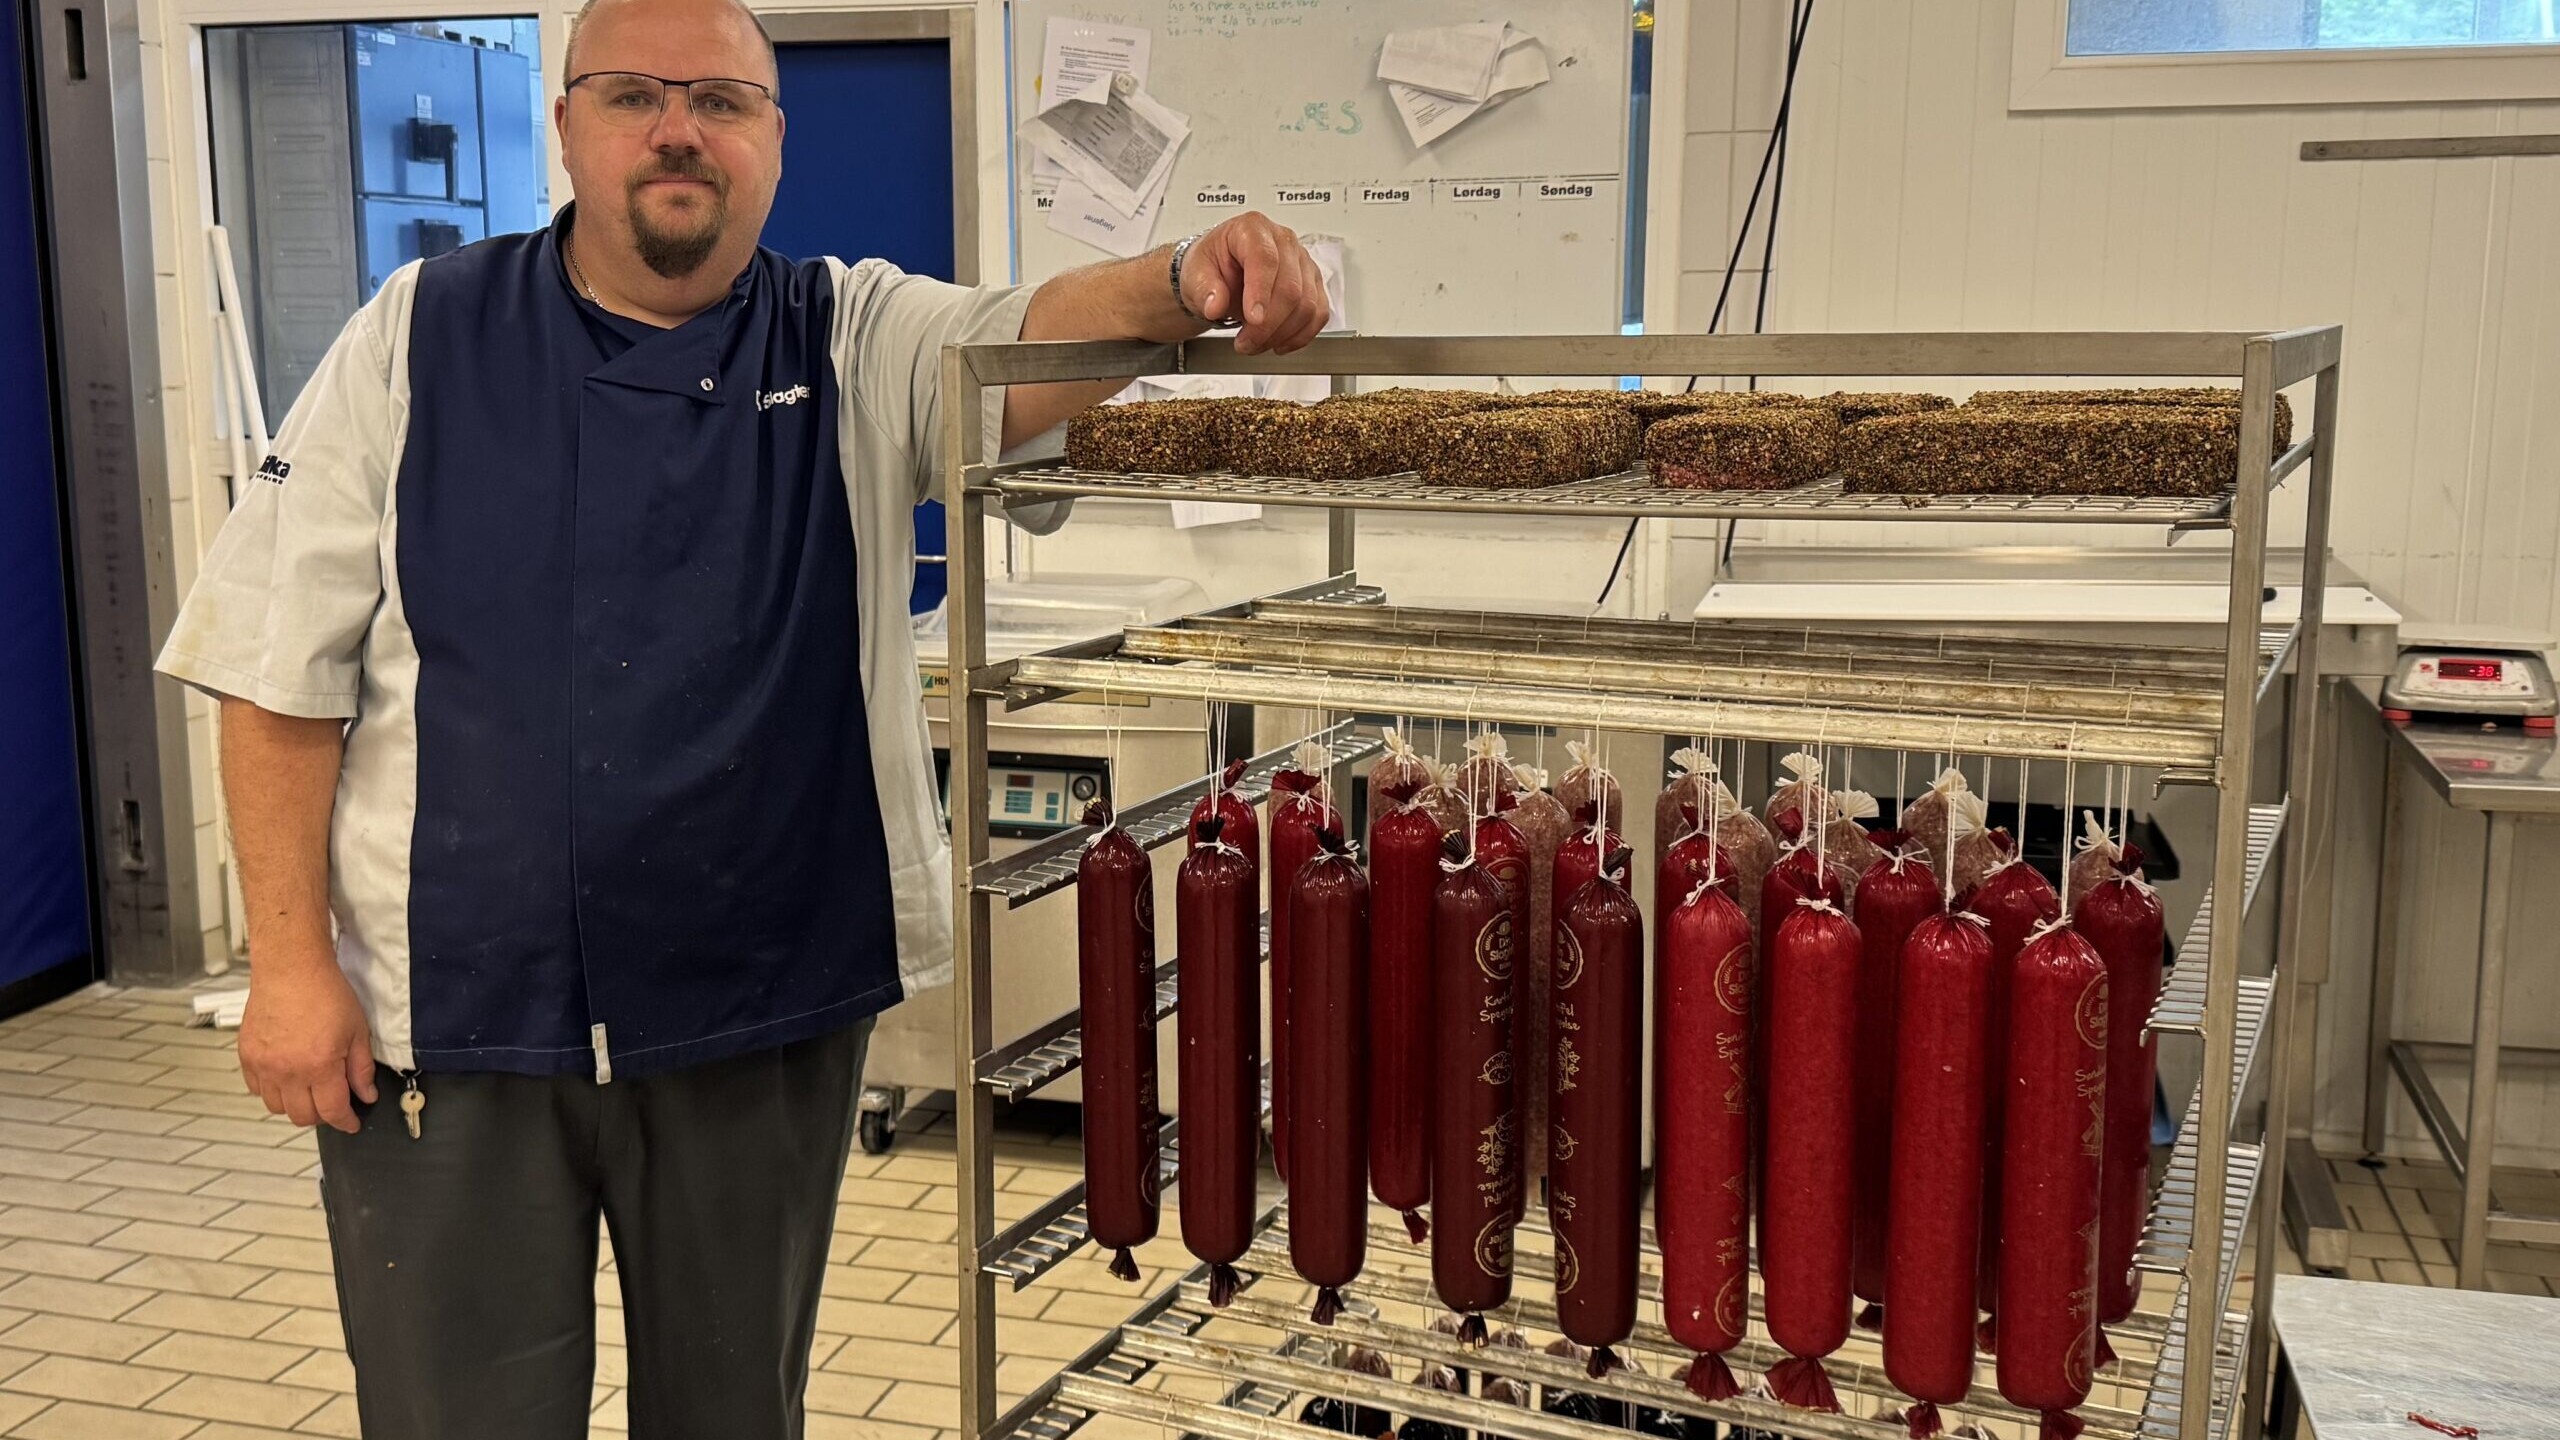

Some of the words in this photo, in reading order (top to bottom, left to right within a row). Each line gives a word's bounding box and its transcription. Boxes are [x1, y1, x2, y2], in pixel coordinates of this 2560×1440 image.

[1197, 192, 1245, 204] Onsdag
[1277, 191, 1331, 202] Torsdag
[1363, 189, 1410, 201] Fredag
[1453, 187, 1500, 199] Lørdag
[1540, 185, 1593, 197] Søndag
